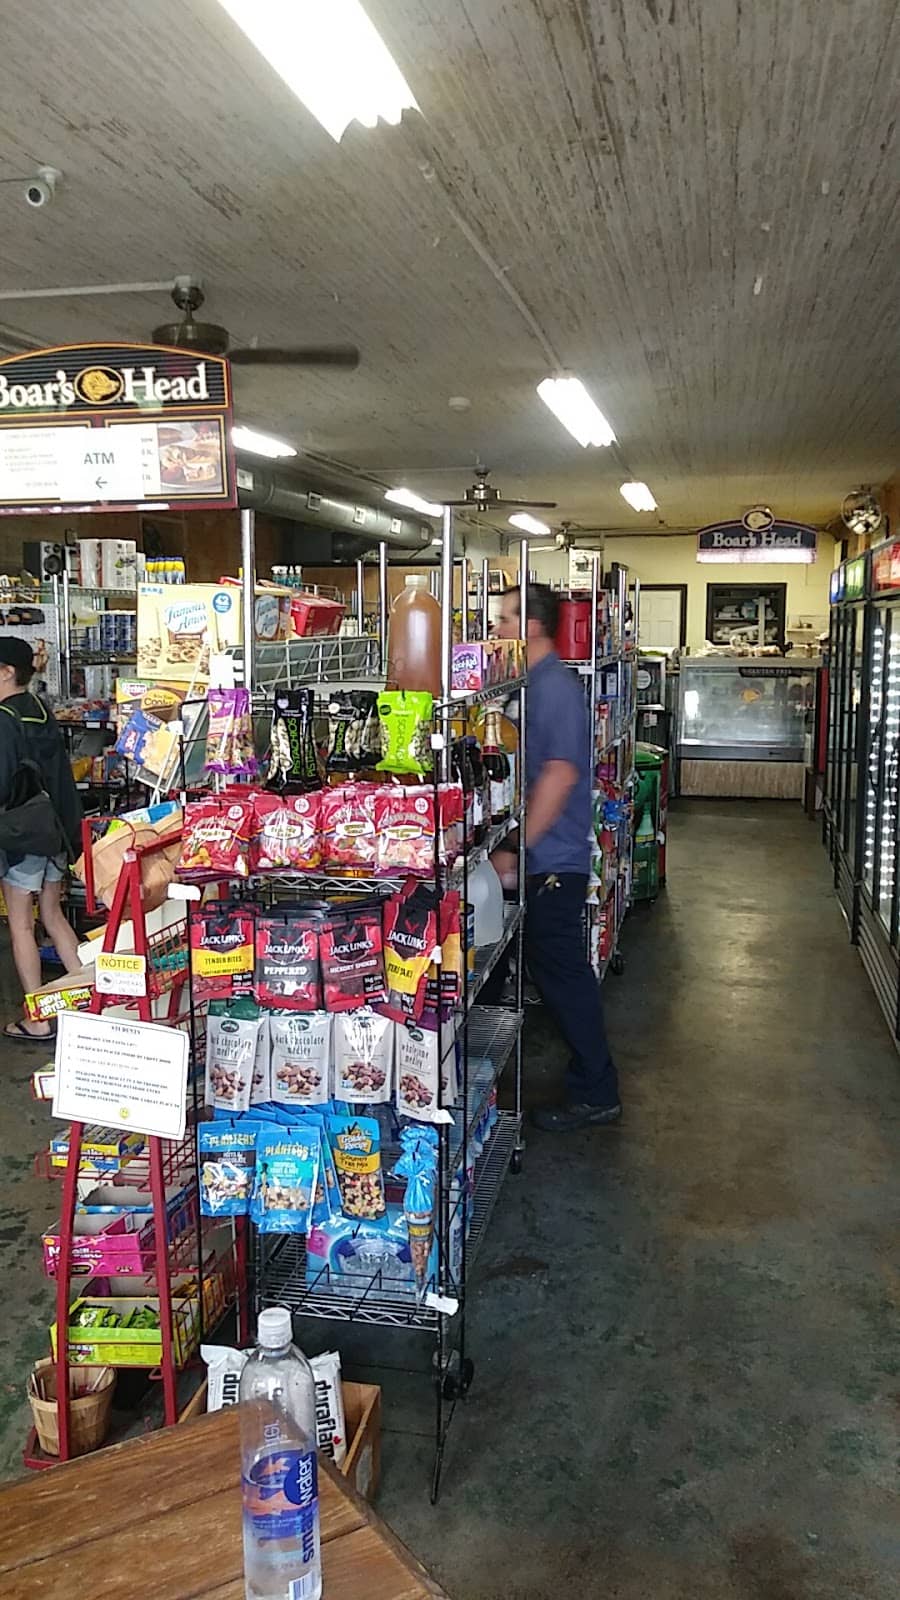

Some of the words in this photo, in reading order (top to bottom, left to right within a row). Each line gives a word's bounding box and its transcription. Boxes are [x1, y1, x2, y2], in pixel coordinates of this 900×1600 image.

[121, 362, 209, 401] Head
[83, 451, 115, 465] ATM
[712, 531, 756, 547] Boar's
[761, 531, 802, 547] Head
[101, 958, 140, 970] NOTICE
[264, 966, 308, 975] PEPPERED
[313, 1379, 335, 1463] duraflam
